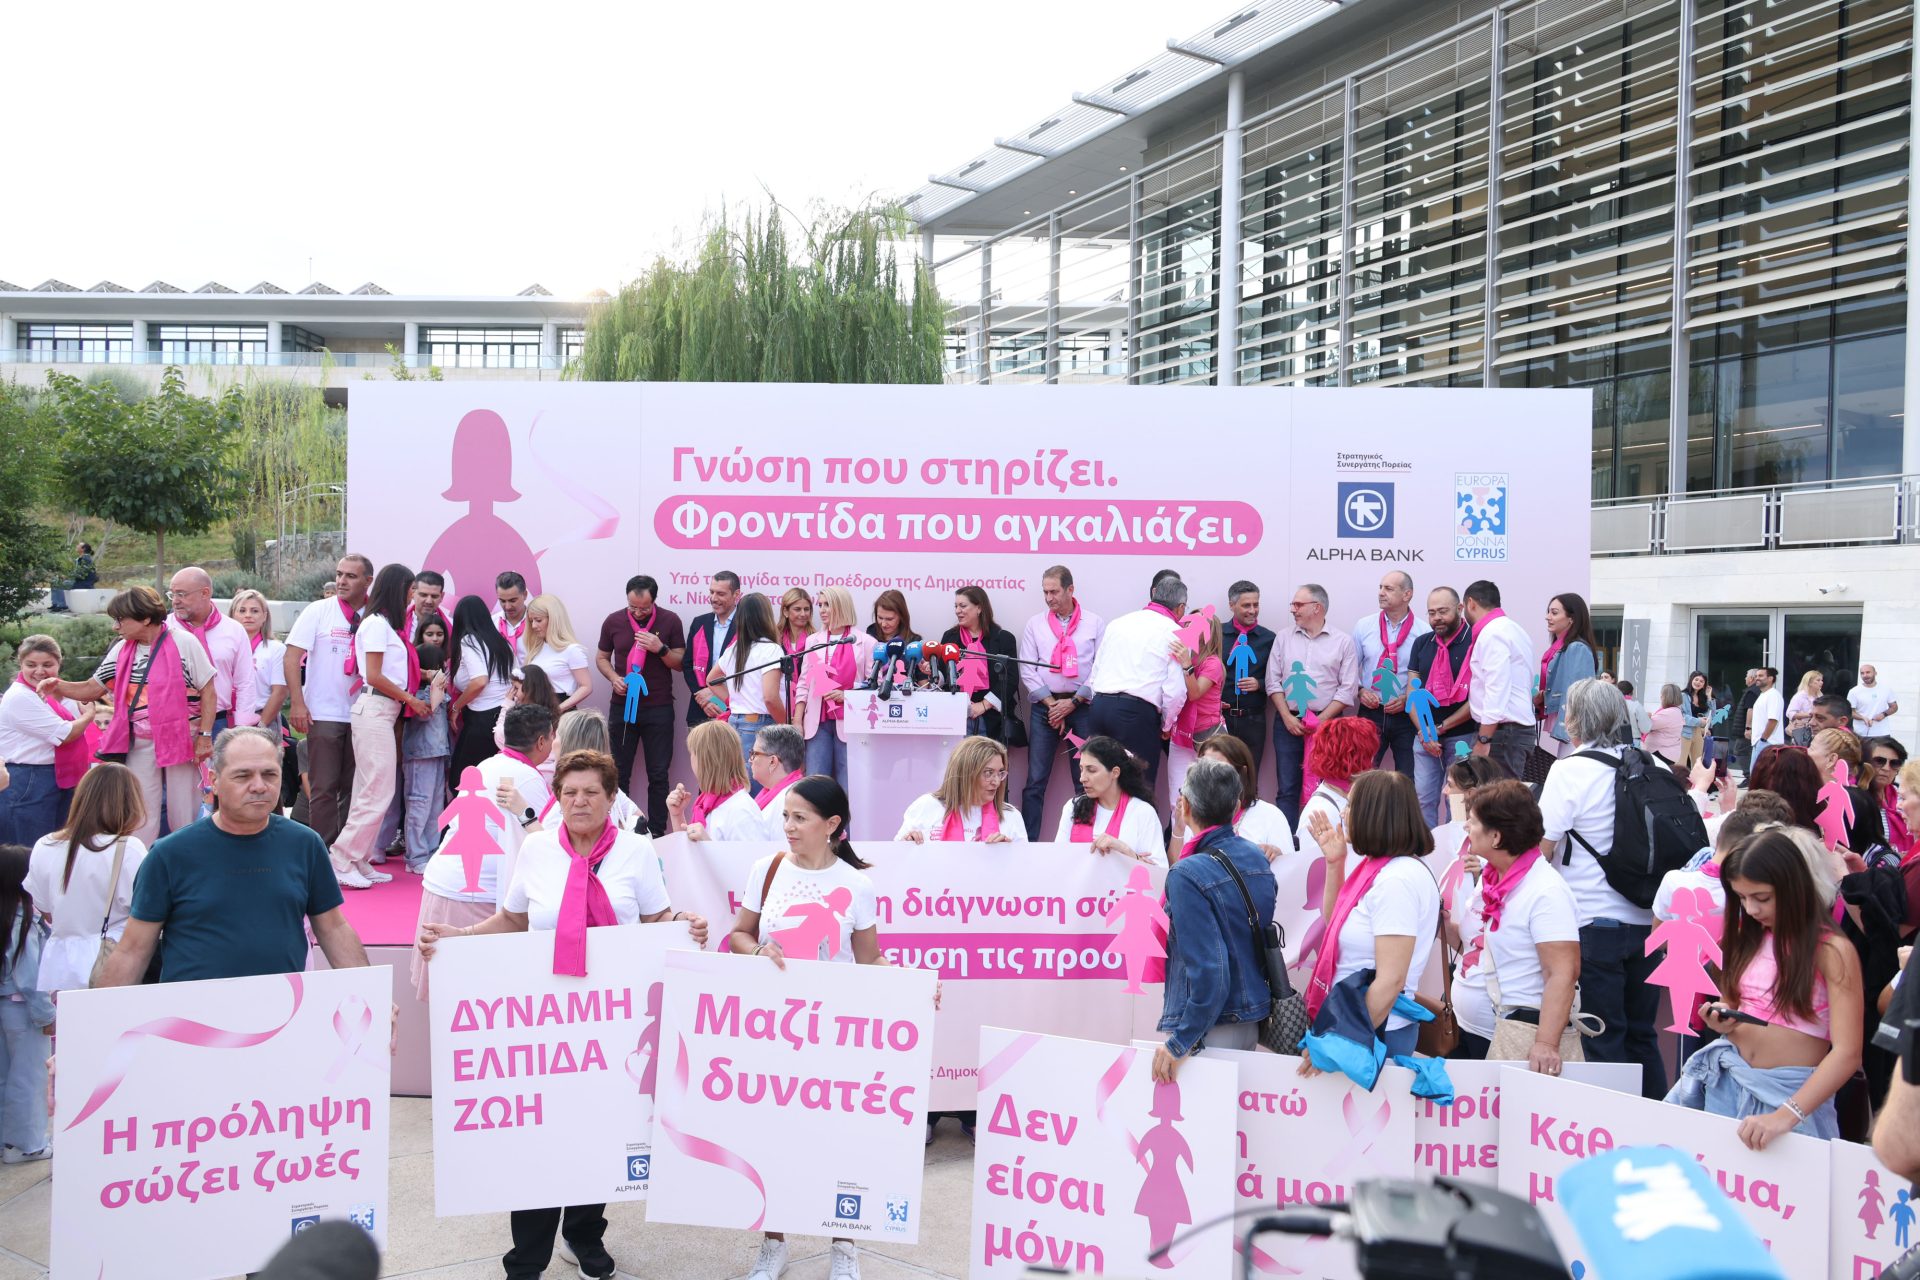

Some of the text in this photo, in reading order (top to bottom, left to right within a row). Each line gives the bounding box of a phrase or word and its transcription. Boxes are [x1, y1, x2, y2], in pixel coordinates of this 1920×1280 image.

[673, 446, 1118, 495] Γνώση που στηρίζει.
[1337, 452, 1383, 460] Στρατηγικός
[1337, 461, 1412, 469] Συνεργάτης Πορείας
[1457, 475, 1506, 486] EUROPA
[672, 500, 1247, 551] Φροντίδα που αγκαλιάζει.
[1456, 536, 1506, 546] DONNA
[1306, 548, 1424, 562] ALPHA BANK
[1456, 548, 1506, 559] CYPRUS
[670, 571, 699, 585] Υπό
[782, 574, 809, 587] του
[814, 573, 892, 590] Προέδρου
[896, 576, 920, 590] της
[925, 575, 1025, 592] Δημοκρατίας
[903, 887, 1065, 924] διάγνωση
[881, 947, 1122, 977] ευση τις προο
[451, 987, 632, 1032] ΔΥΝΑΜΗ
[694, 993, 919, 1052] Μαζί πιο
[453, 1039, 608, 1082] ΕΛΠΙΔΑ
[936, 1066, 979, 1080] Δημοκ
[702, 1056, 916, 1126] δυνατές
[1238, 1088, 1307, 1117] ατώ
[103, 1096, 371, 1155] Η πρόληψη
[453, 1093, 543, 1132] ΖΩΗ
[987, 1093, 1078, 1146] Δεν
[1531, 1112, 1627, 1158] Κάθ
[100, 1143, 360, 1209] σώζει ζωές
[615, 1184, 642, 1192] ALPHA
[986, 1155, 1106, 1216] είσαι
[821, 1220, 872, 1231] ALPHA BANK
[984, 1219, 1104, 1275] μόνη
